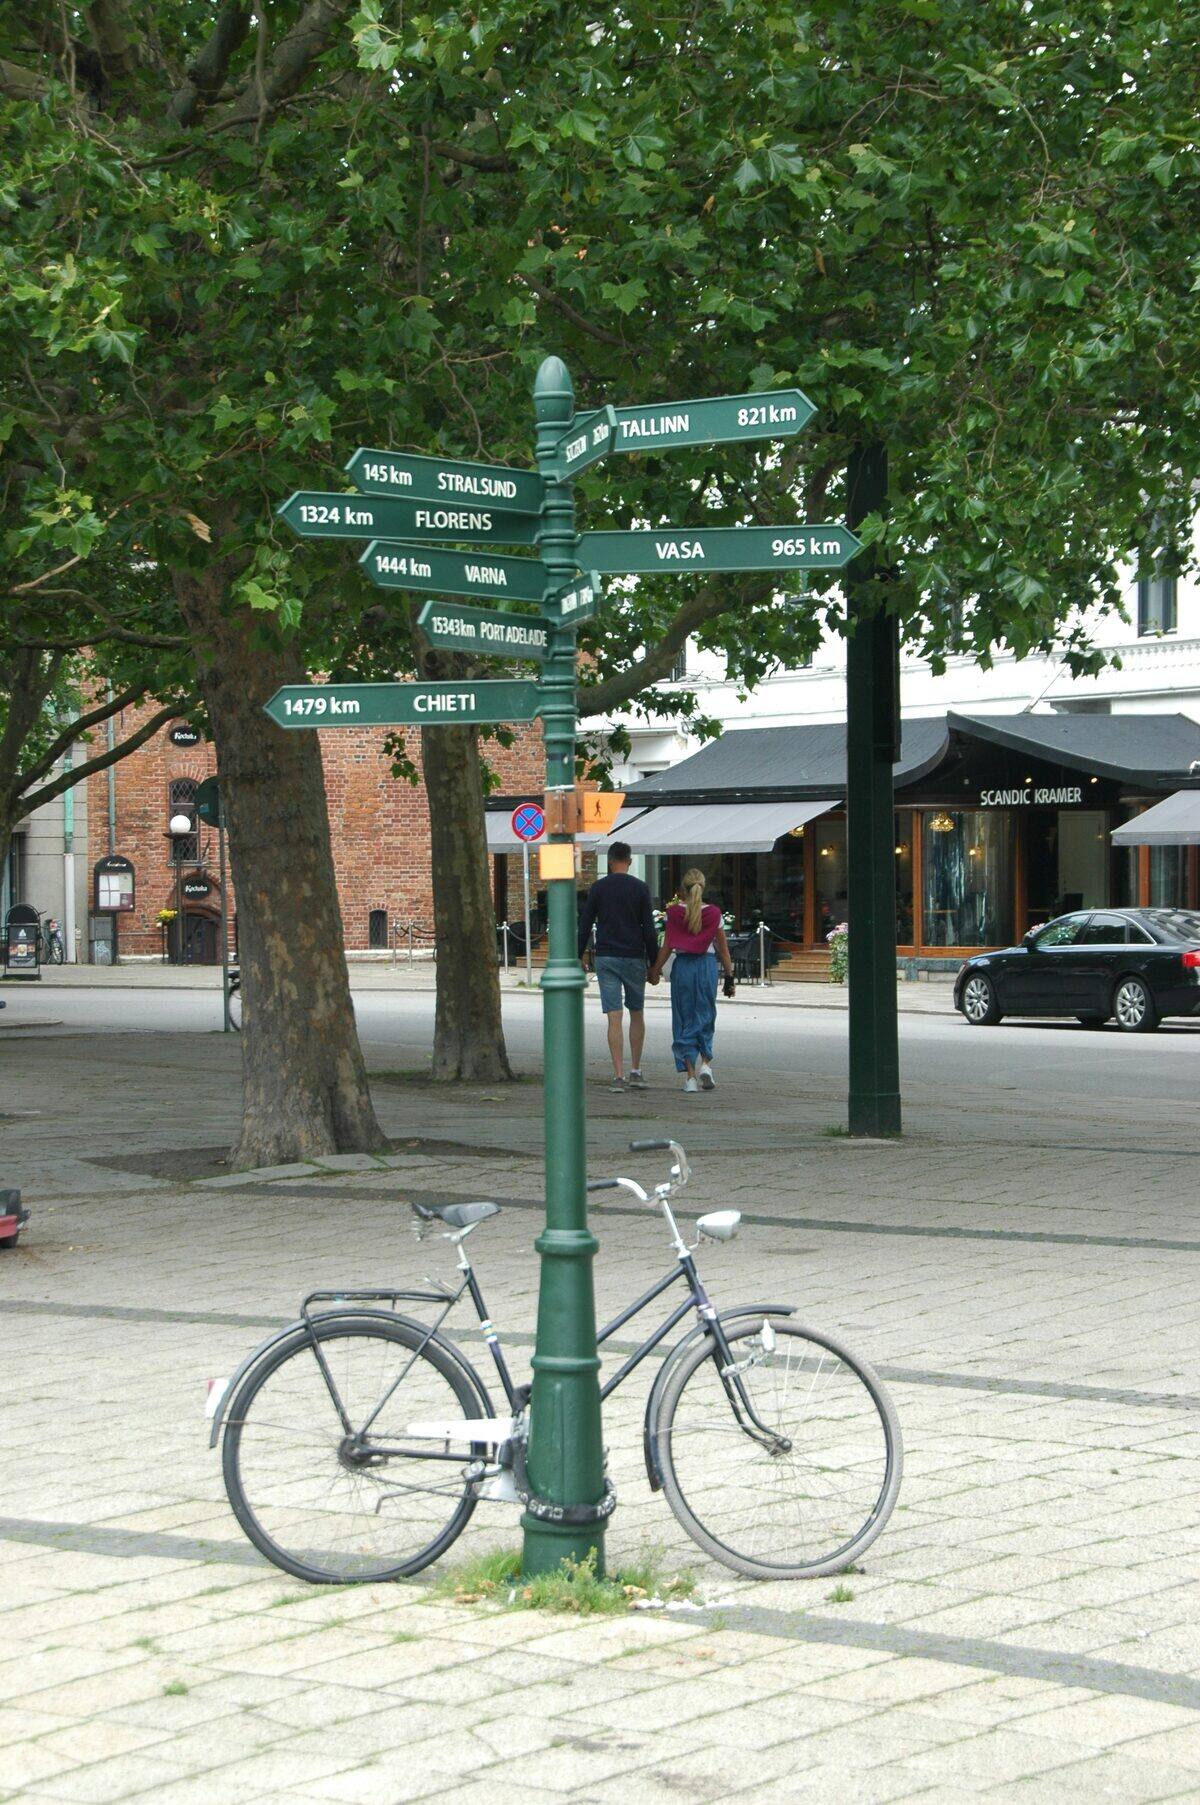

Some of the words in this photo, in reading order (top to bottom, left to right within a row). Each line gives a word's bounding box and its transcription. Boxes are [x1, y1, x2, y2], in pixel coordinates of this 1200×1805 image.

[620, 415, 689, 437] TALLINN
[738, 407, 766, 426] 821
[770, 405, 796, 422] km
[364, 464, 388, 482] 145
[390, 465, 412, 485] km
[438, 473, 516, 498] STRALSUND
[300, 506, 340, 523] 1324
[345, 507, 373, 525] km
[416, 511, 492, 530] FLORENS
[656, 542, 704, 559] VASA
[772, 539, 805, 556] 965
[810, 538, 840, 554] km
[376, 556, 407, 574] 1444
[410, 558, 431, 577] km
[465, 565, 507, 585] VARNA
[481, 622, 505, 641] PORT
[506, 626, 547, 646] ADELAIDE
[284, 698, 326, 715] 1479
[330, 697, 359, 713] km
[414, 694, 475, 712] CHIETI
[981, 789, 1030, 805] SCANDIC
[1035, 788, 1081, 803] KRAMER
